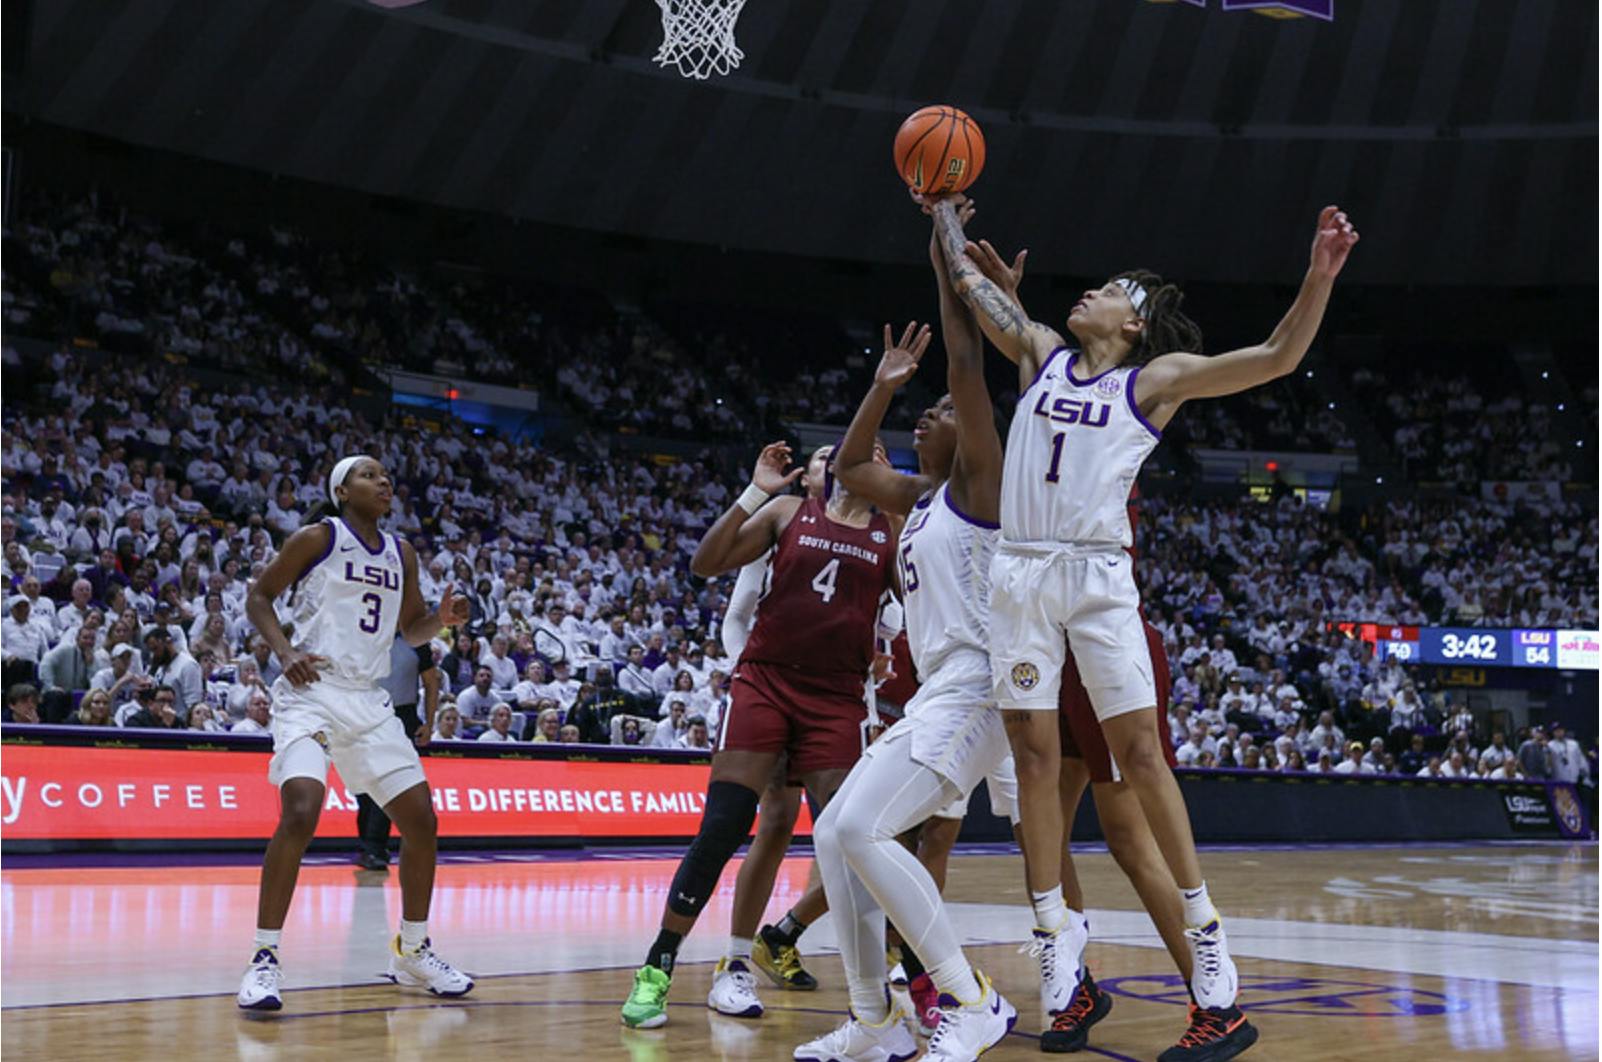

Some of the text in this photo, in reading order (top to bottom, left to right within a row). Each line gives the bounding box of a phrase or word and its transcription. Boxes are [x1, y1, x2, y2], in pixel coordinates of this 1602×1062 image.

[1034, 391, 1111, 428] LSU
[1045, 432, 1066, 483] 1
[799, 534, 878, 565] SOUTH CAROLINA
[345, 562, 399, 591] LSU
[811, 558, 840, 603] 4
[360, 592, 382, 633] 3
[1442, 634, 1498, 660] 3:42
[1521, 632, 1550, 644] LSU
[1525, 647, 1550, 664] 54
[1437, 668, 1486, 686] LSU
[40, 782, 238, 809] COFFEE
[468, 788, 625, 813] DIFFERENCE
